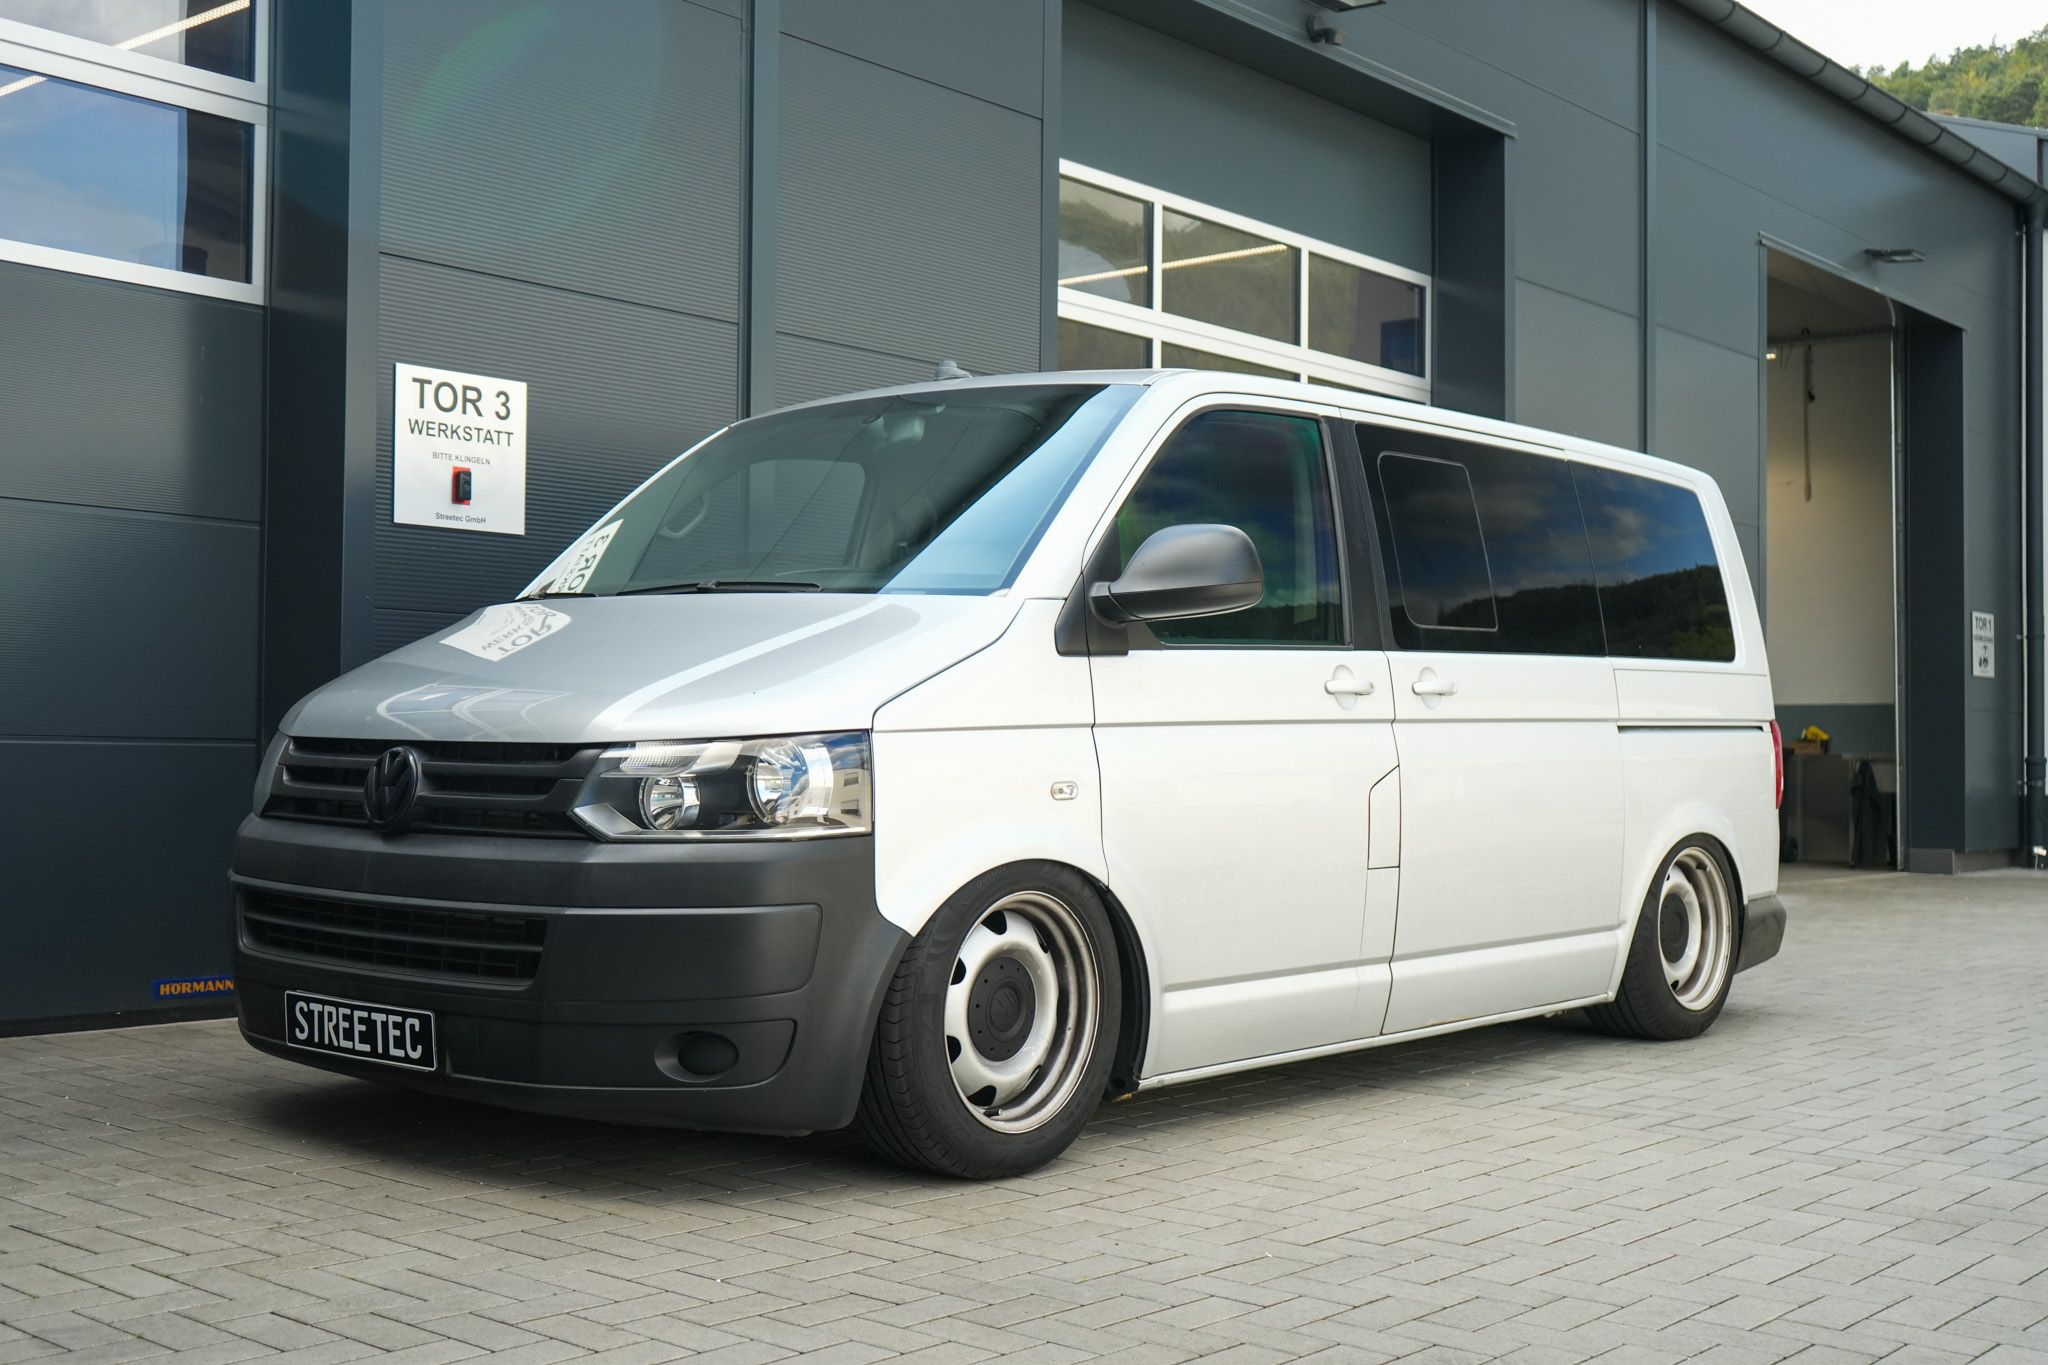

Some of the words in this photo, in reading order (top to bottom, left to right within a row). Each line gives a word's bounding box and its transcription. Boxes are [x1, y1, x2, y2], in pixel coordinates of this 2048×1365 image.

[412, 377, 483, 417] TOR
[494, 390, 511, 421] 3
[408, 418, 514, 447] WERKSTATT
[432, 451, 453, 461] BITTE
[454, 454, 491, 465] KLINGELN
[435, 512, 463, 522] Streetec
[465, 514, 487, 524] GmbH
[1975, 616, 1987, 631] TOR
[295, 1001, 423, 1060] STREETEC
